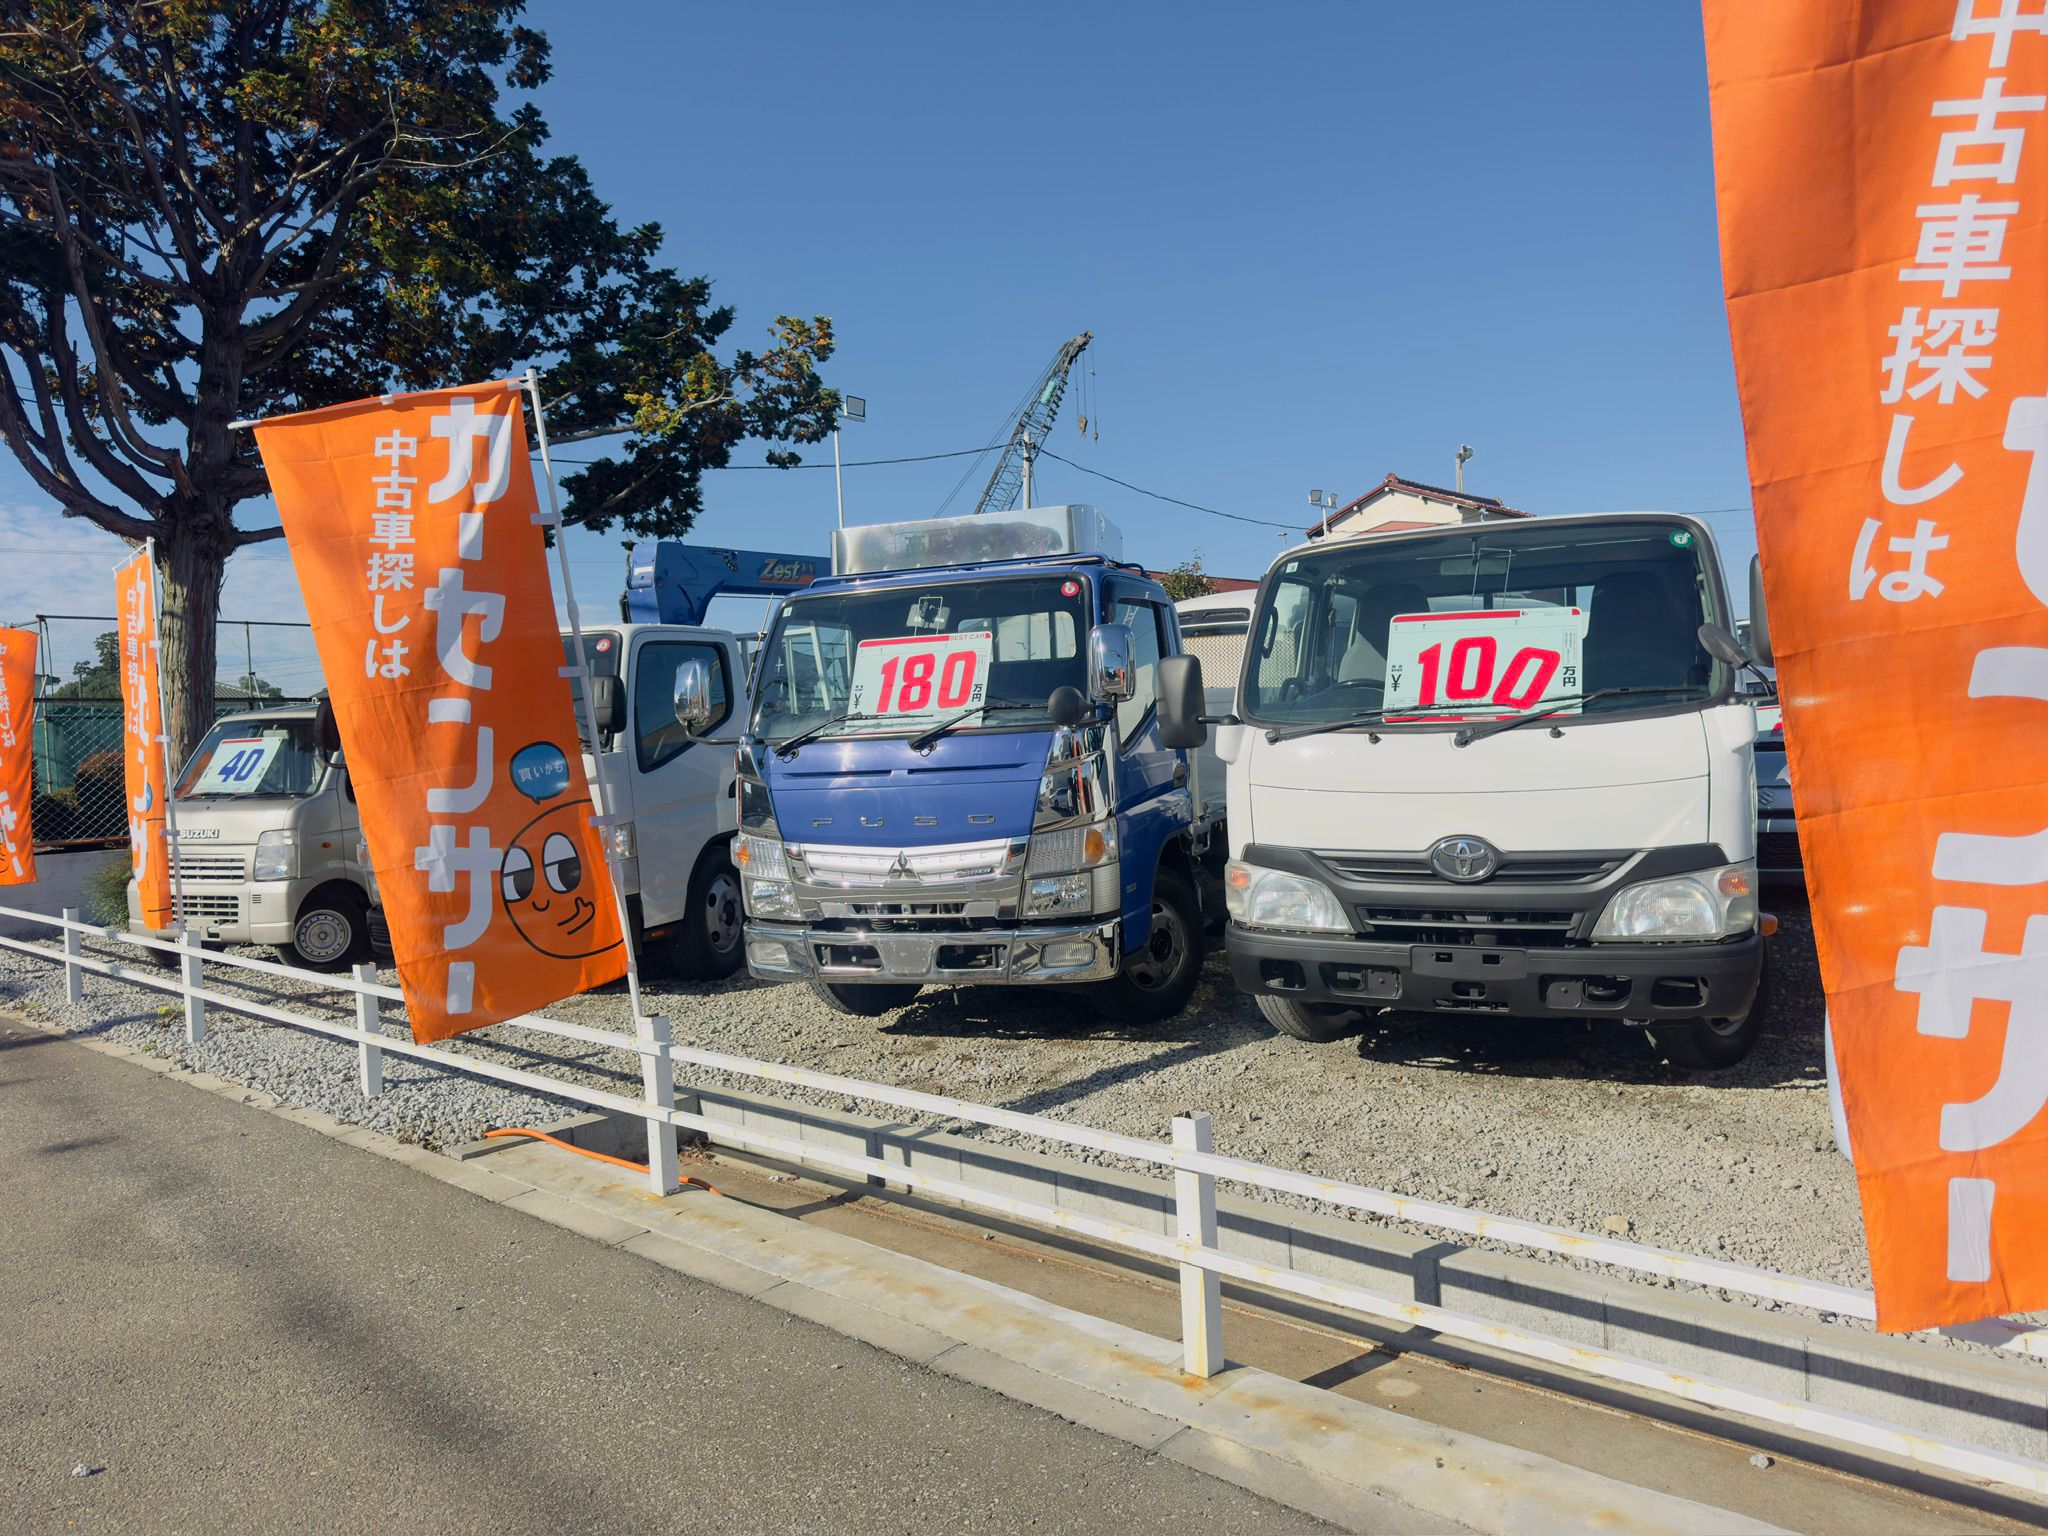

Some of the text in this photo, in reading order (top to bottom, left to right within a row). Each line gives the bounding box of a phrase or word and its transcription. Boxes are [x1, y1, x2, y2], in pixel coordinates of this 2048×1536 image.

[365, 429, 418, 679] 中古車探しは
[760, 559, 800, 579] Zest
[876, 650, 977, 713] 180
[972, 683, 983, 703] 万円
[1391, 673, 1402, 692] ¥
[1417, 636, 1561, 710] 100
[1562, 665, 1577, 687] 万円
[415, 397, 512, 1014] カーセンサー
[218, 749, 265, 782] 40
[180, 829, 220, 839] SUZUKI
[812, 814, 996, 828] FUSO
